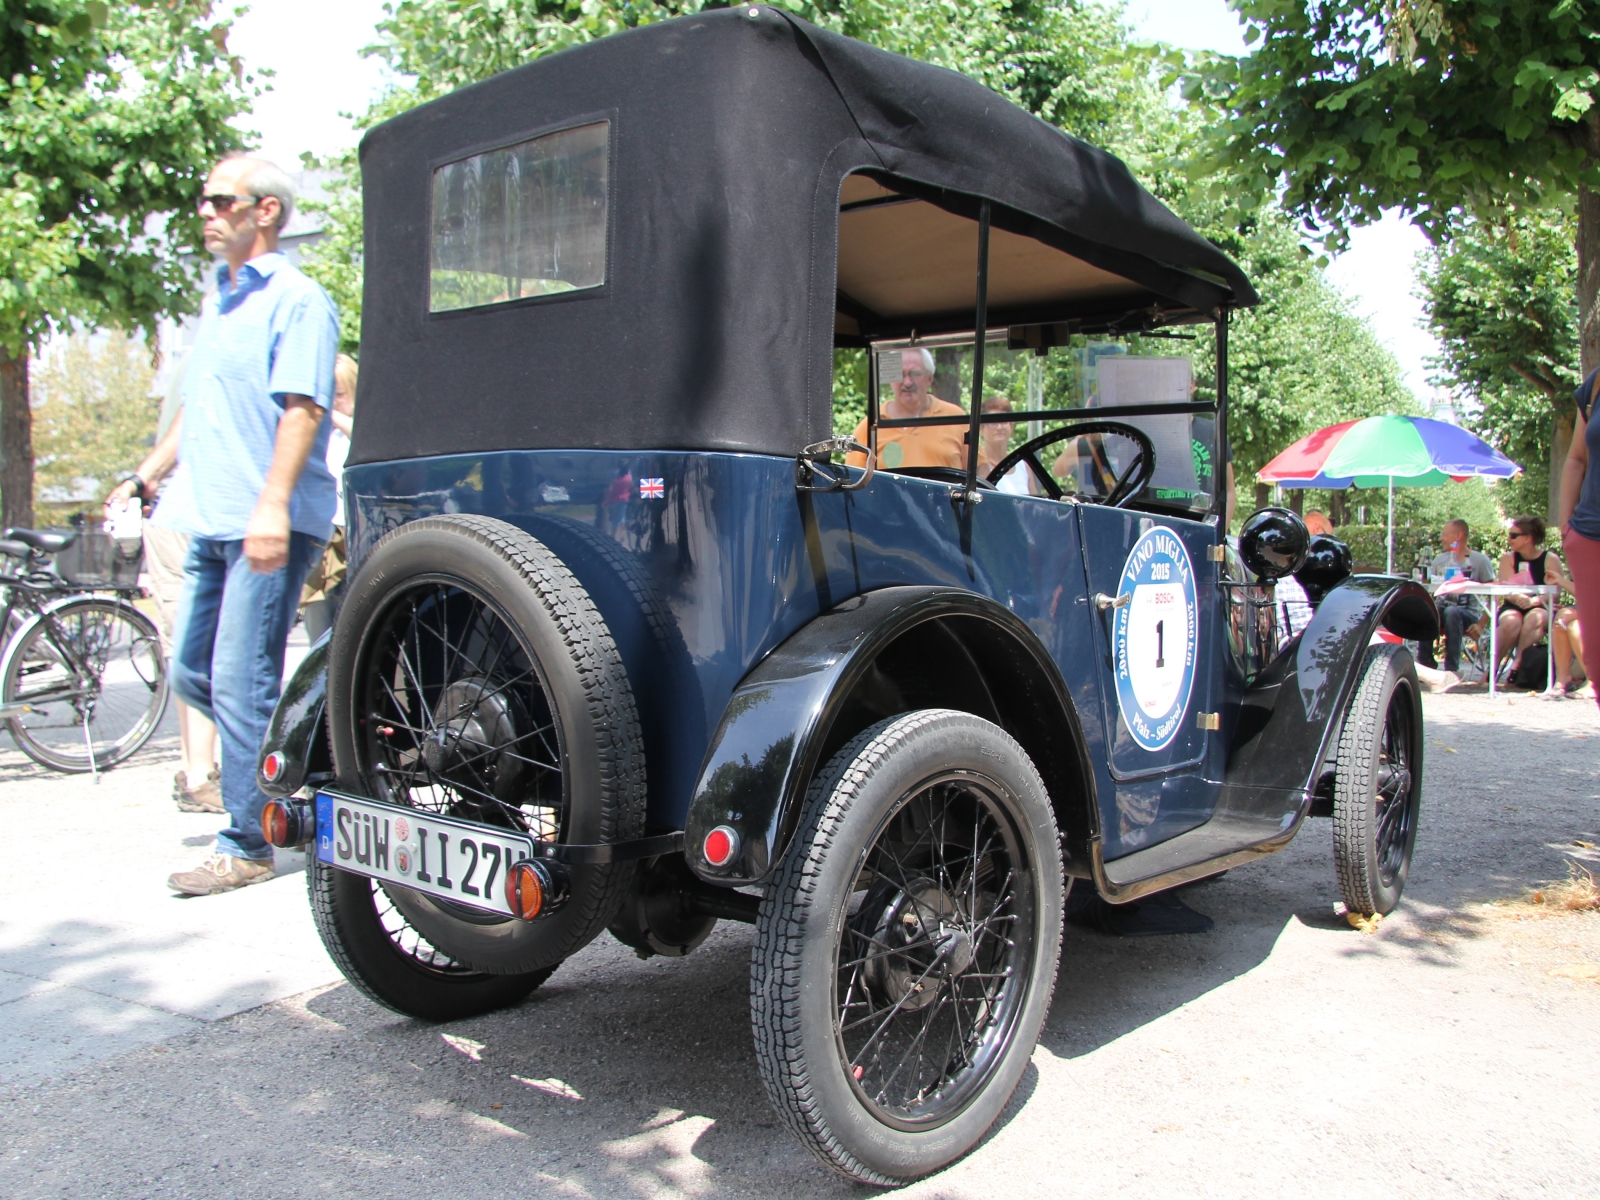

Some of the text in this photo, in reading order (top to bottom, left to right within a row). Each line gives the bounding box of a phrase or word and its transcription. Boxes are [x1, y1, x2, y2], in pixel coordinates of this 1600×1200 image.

[1127, 535, 1188, 585] VINO MIGLIA
[1151, 563, 1170, 580] 2015
[1155, 593, 1174, 604] BOSCH
[1118, 608, 1129, 680] 2000 km
[1156, 620, 1165, 668] 1
[1186, 601, 1195, 667] 2000 km
[1132, 711, 1150, 740] Pfalz
[1156, 703, 1182, 741] Südtirol
[322, 835, 329, 850] D
